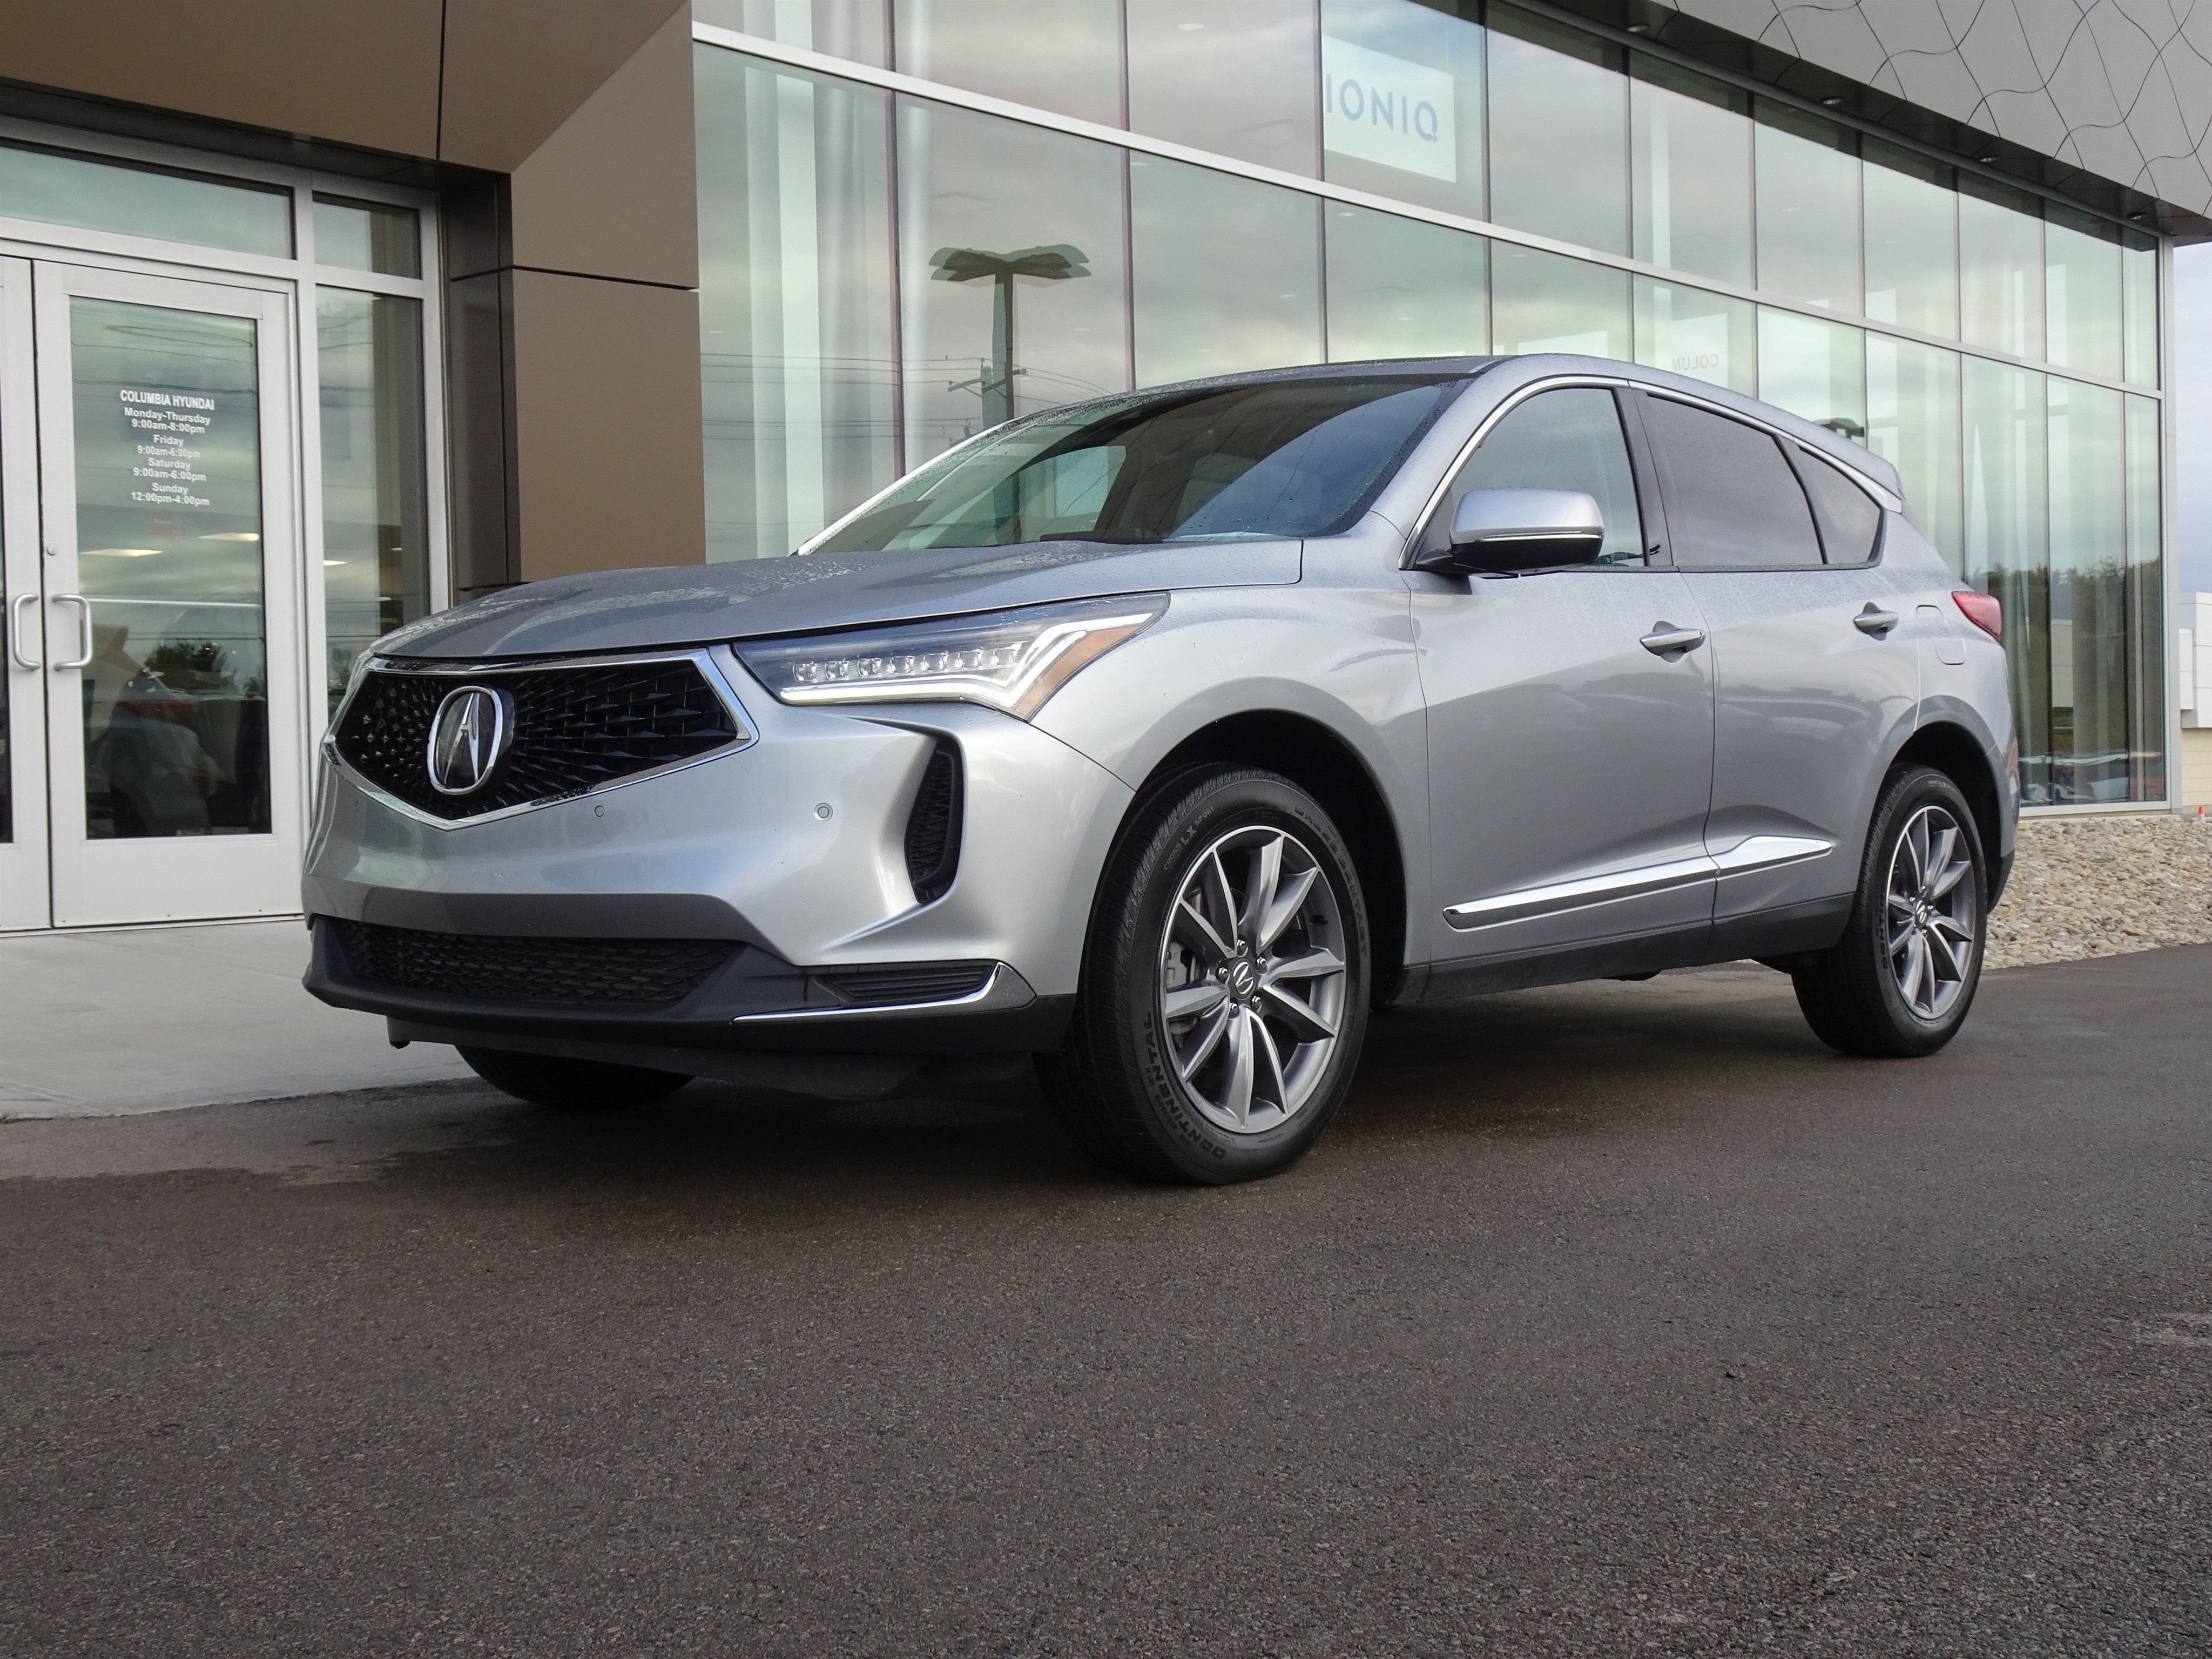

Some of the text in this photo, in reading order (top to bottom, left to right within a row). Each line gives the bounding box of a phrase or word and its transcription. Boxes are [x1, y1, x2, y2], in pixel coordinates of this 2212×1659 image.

[1326, 73, 1438, 143] IONIQ
[120, 389, 215, 410] COLUMBIA HYUNDAI
[124, 407, 211, 426] Monday-Thursday
[132, 419, 205, 434] 9:00am-8:00pm
[153, 434, 184, 447] Friday
[137, 445, 200, 459] 9:00am-6:00pm
[148, 457, 191, 471] Saturday
[133, 467, 206, 482] 9:00am-6:00pm
[152, 482, 188, 495] Sunday
[131, 491, 210, 507] 12:00pm-4:00pm
[1164, 842, 1182, 871] CROSS
[1180, 825, 1197, 846] LX
[1194, 806, 1215, 826] SPORT
[1144, 1011, 1227, 1159] CONTINENTAL
